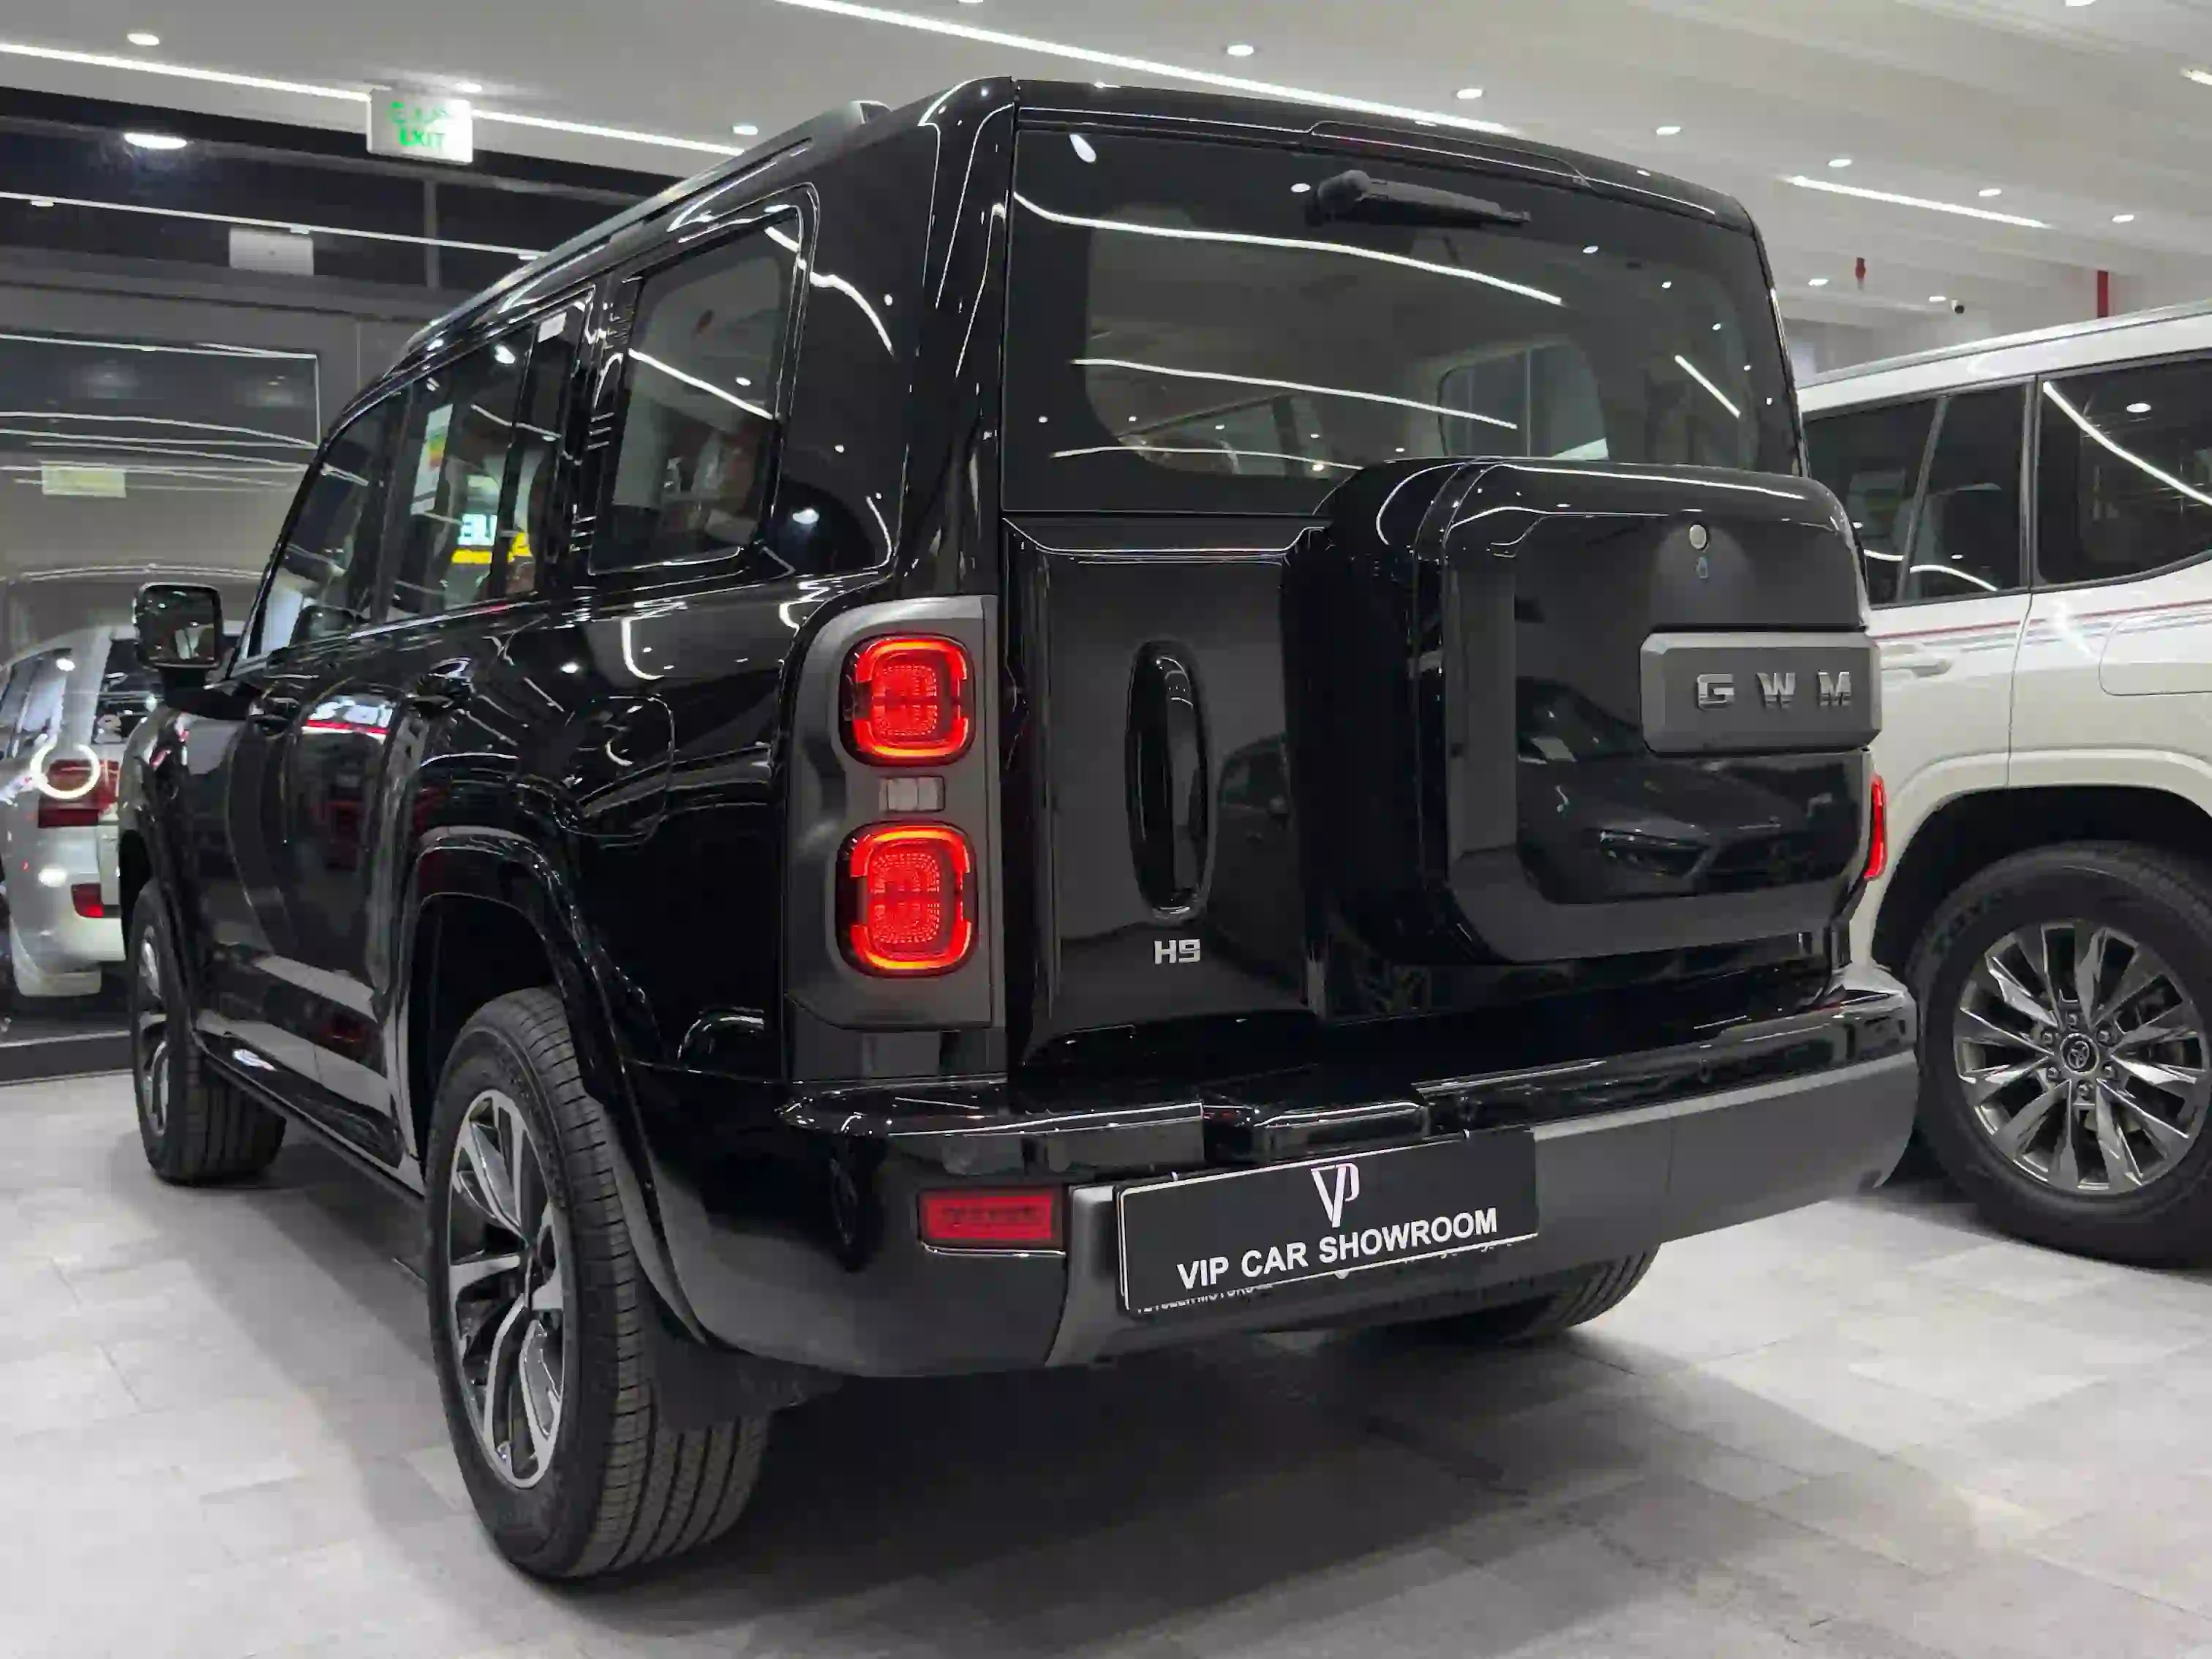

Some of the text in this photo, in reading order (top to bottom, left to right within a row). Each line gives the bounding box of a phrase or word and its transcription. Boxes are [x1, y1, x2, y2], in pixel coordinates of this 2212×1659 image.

[1154, 938, 1200, 964] H9
[1176, 1256, 1229, 1290] VIP
[1241, 1241, 1309, 1277] CAR
[1319, 1207, 1497, 1263] SHOWROOM
